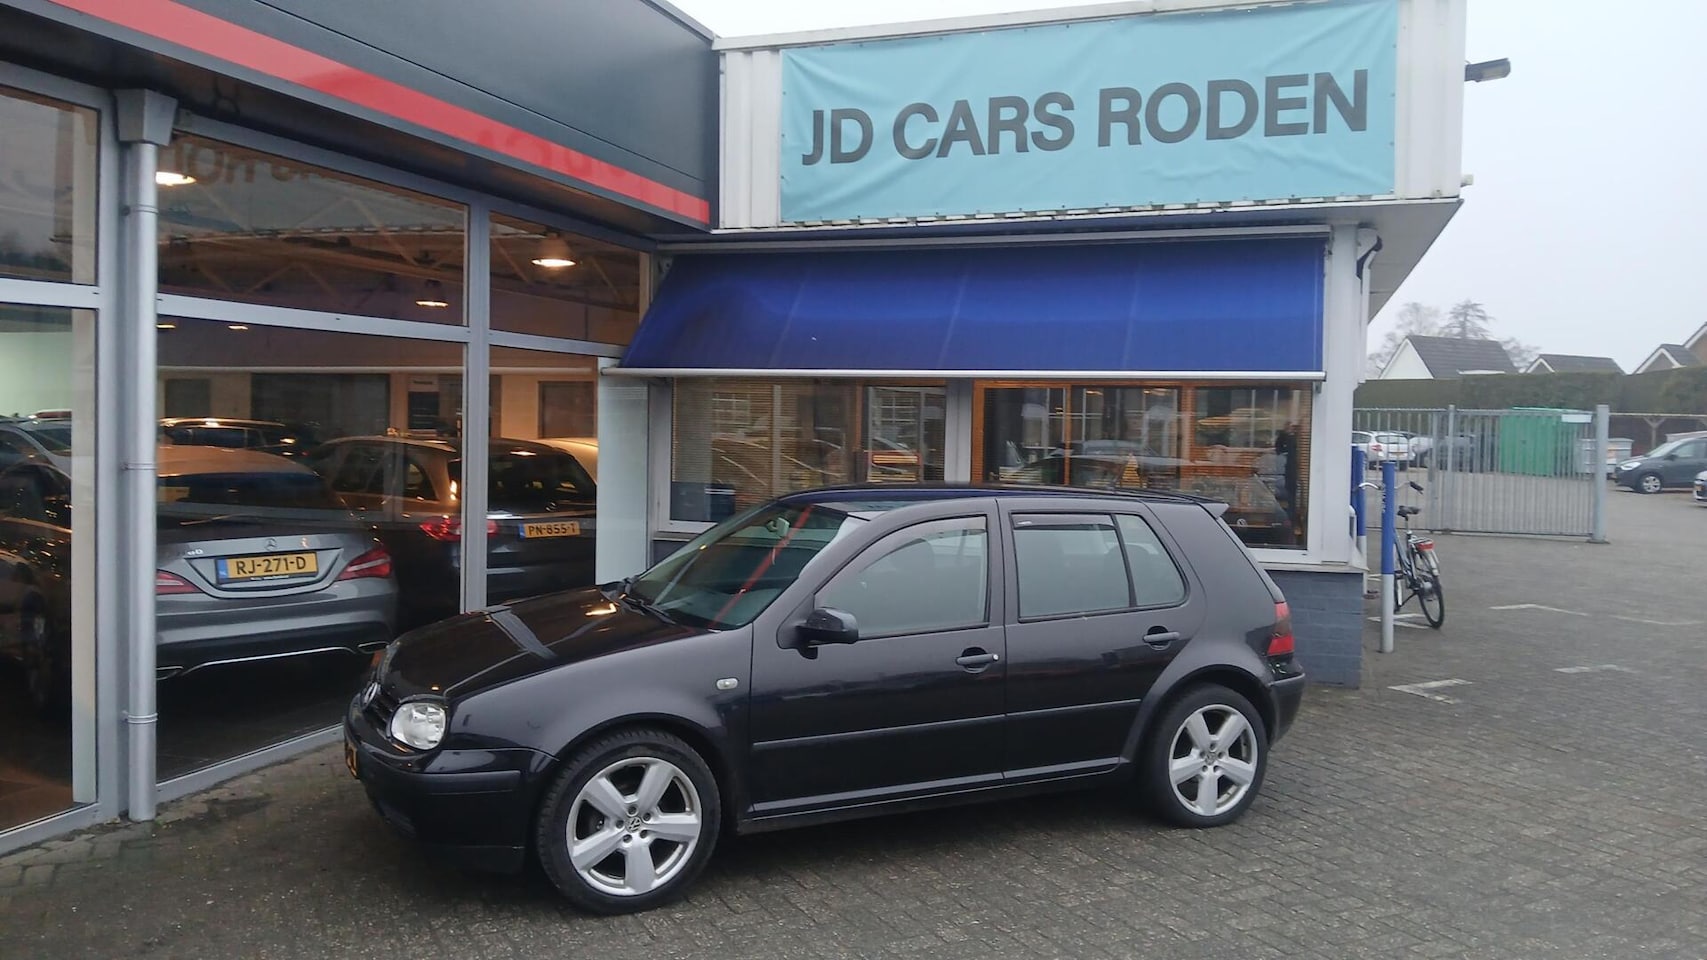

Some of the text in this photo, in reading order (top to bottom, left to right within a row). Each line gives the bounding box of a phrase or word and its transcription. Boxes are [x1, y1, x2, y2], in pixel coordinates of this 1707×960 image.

[801, 69, 1368, 166] JD CARS RODEN
[235, 556, 306, 575] RJ-271-D
